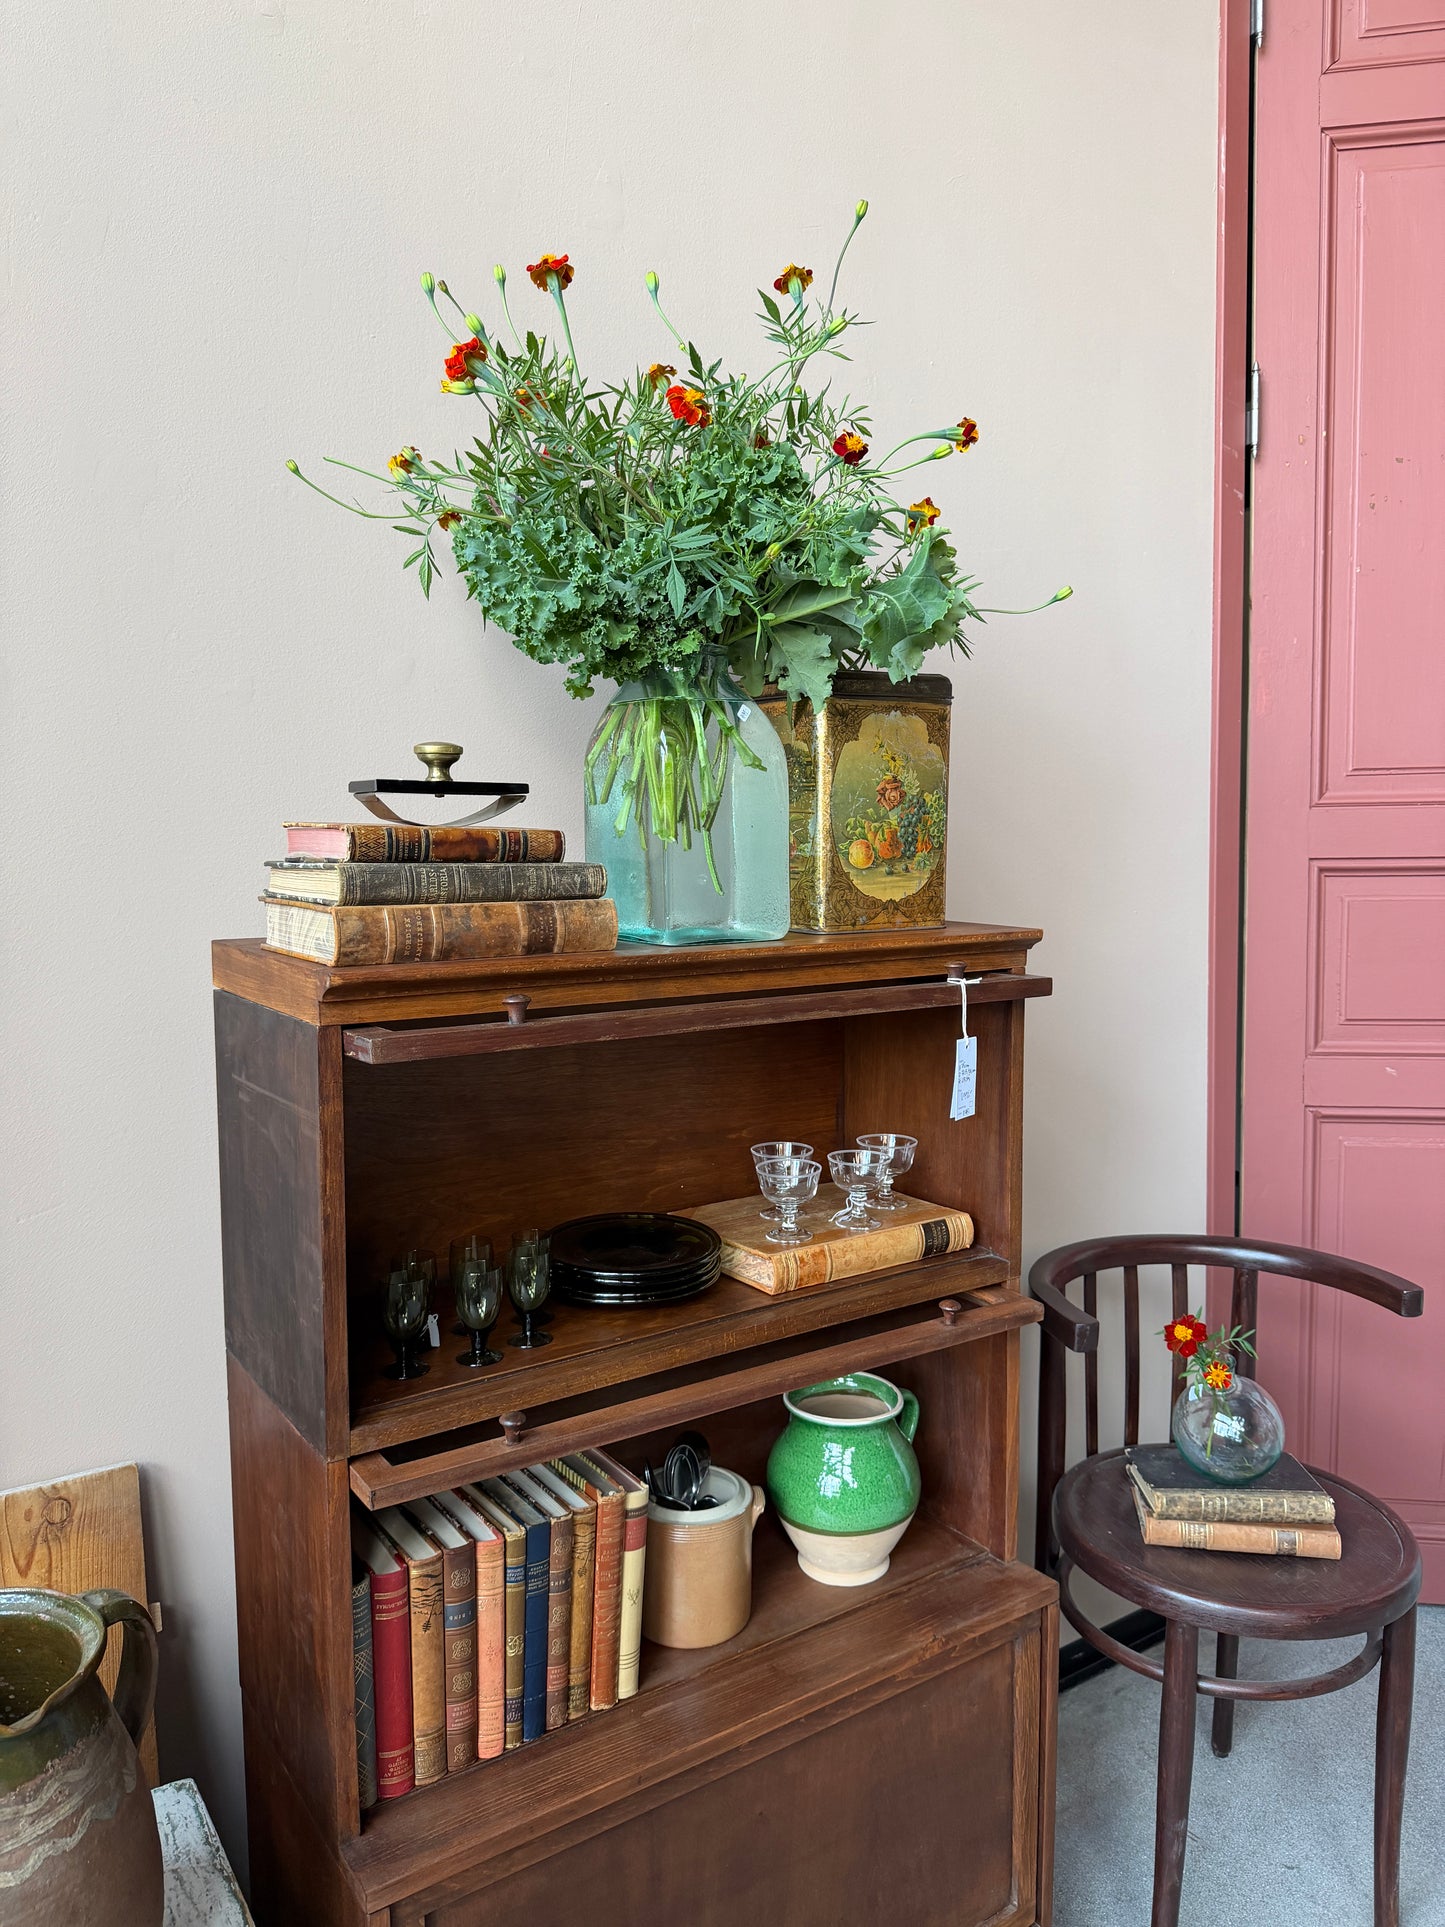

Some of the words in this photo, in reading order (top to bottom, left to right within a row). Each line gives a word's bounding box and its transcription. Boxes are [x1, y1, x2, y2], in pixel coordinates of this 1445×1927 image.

[439, 867, 448, 903] HISTORIA
[404, 917, 412, 956] NORDISK
[414, 909, 423, 962] FAMILJEBOK
